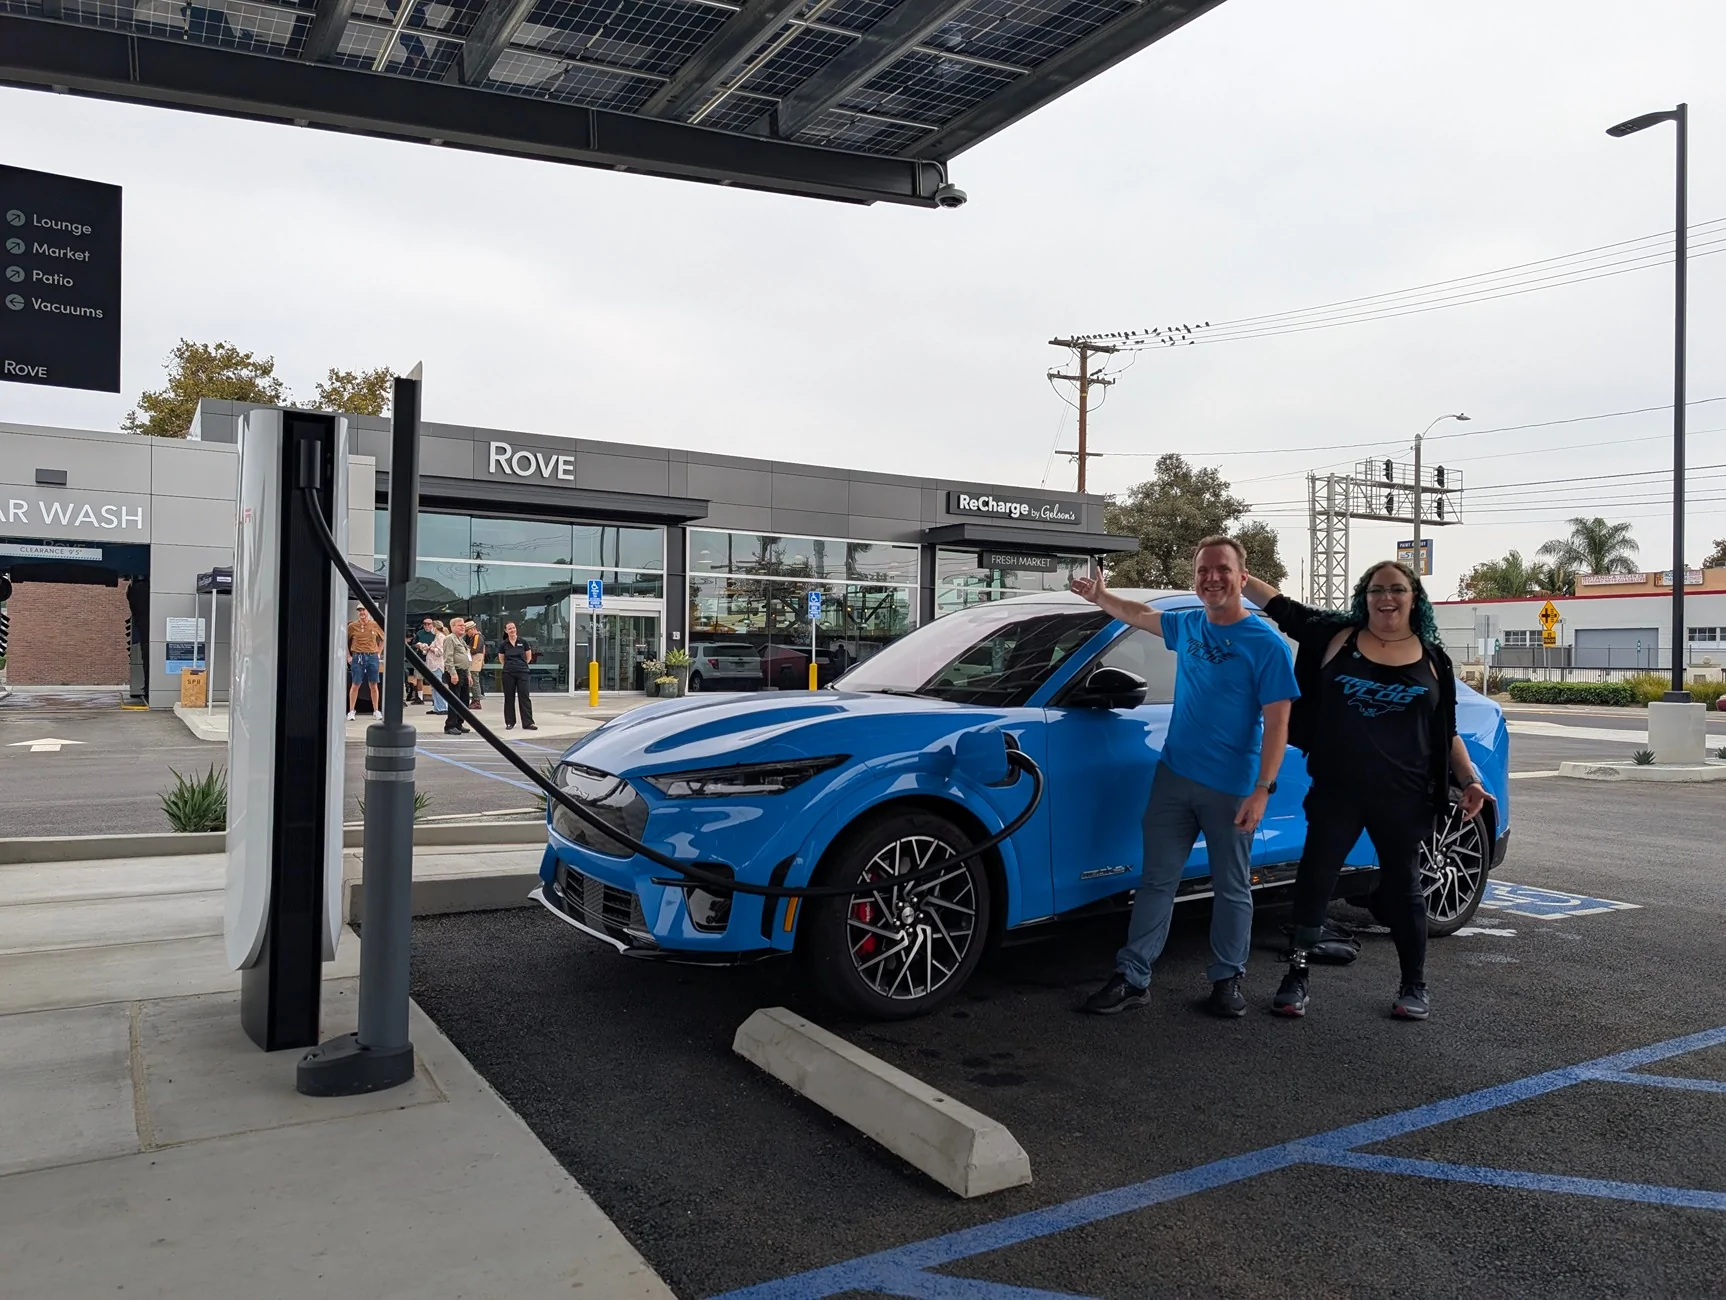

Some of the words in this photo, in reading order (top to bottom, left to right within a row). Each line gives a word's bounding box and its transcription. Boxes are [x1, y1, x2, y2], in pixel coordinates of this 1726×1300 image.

[33, 214, 92, 235] Lounge
[33, 242, 90, 262] Market
[32, 270, 74, 287] Patio
[31, 297, 104, 319] Vacuums
[38, 501, 142, 529] WASH
[960, 495, 1029, 517] ReCharge
[1031, 508, 1040, 519] by
[1041, 504, 1075, 520] Gelson's
[20, 546, 64, 555] CLEARANCE
[991, 555, 1018, 565] FRESH
[1018, 557, 1051, 568] MARKET
[1343, 683, 1417, 703] VLOG
